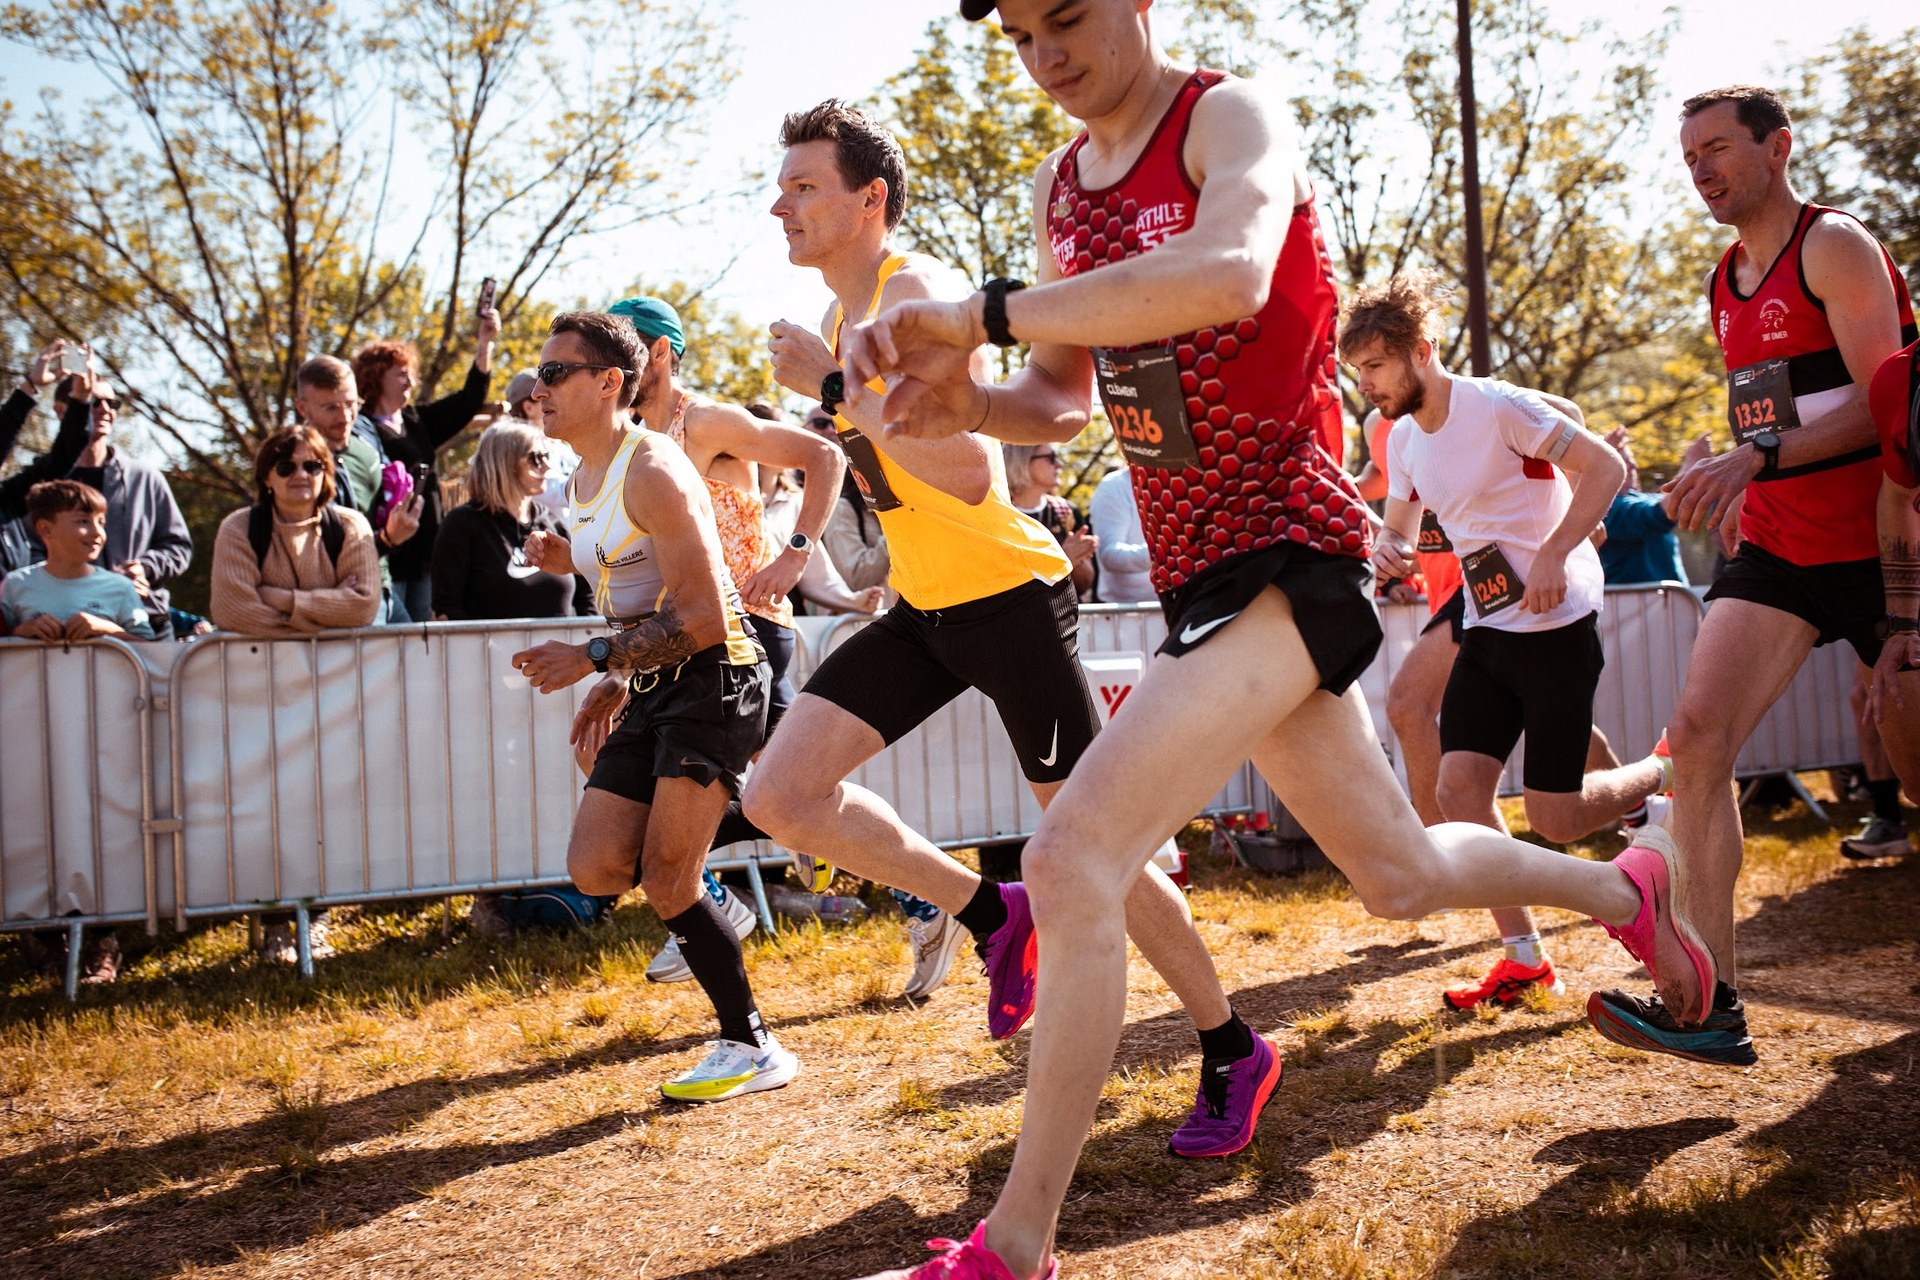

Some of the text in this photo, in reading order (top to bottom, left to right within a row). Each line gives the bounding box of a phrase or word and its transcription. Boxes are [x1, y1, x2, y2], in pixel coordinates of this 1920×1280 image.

[1136, 203, 1187, 232] ATHLE
[1771, 330, 1789, 340] OMER
[1106, 382, 1138, 398] CLÉMENT
[1107, 403, 1163, 444] 1236
[1734, 397, 1776, 429] 1332
[620, 549, 644, 563] VILLERS
[1473, 573, 1508, 604] 1249
